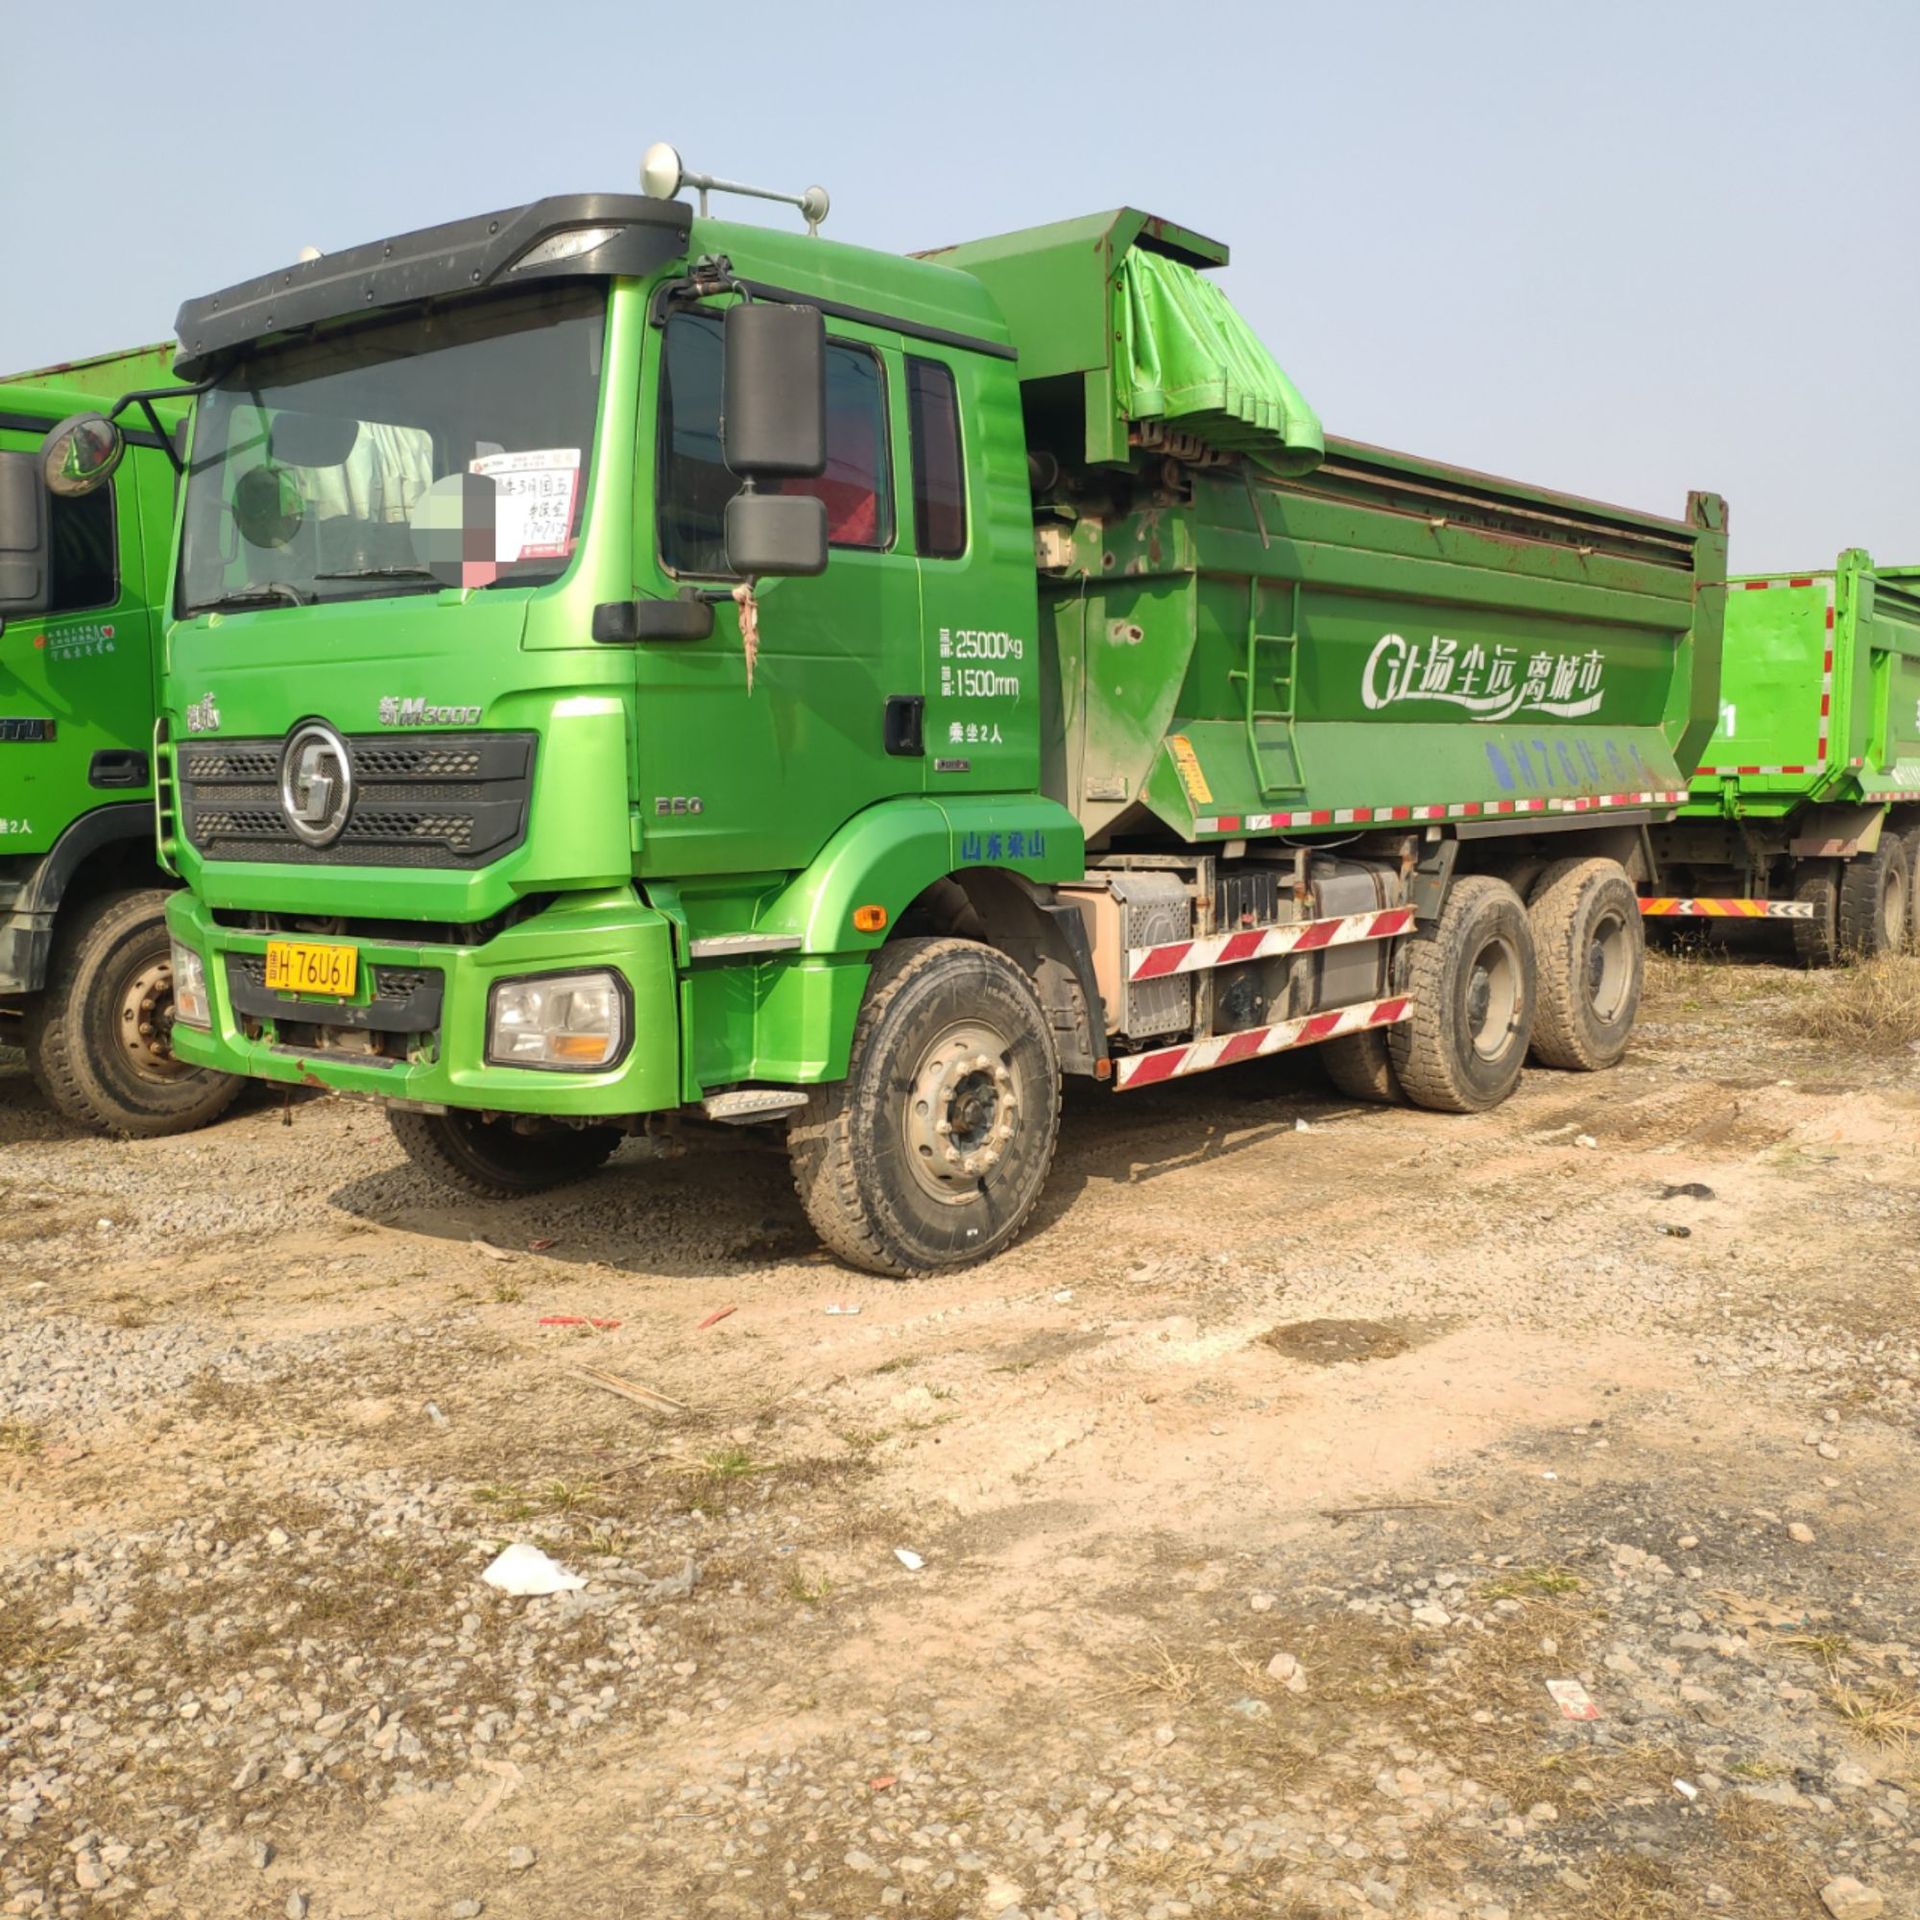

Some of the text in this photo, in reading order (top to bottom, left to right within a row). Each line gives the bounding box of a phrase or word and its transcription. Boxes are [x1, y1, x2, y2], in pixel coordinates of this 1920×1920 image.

[1362, 634, 1606, 706] 让扬尘远离城市
[949, 721, 1003, 744] 乘坐2人
[961, 830, 1046, 861] 山东梁山
